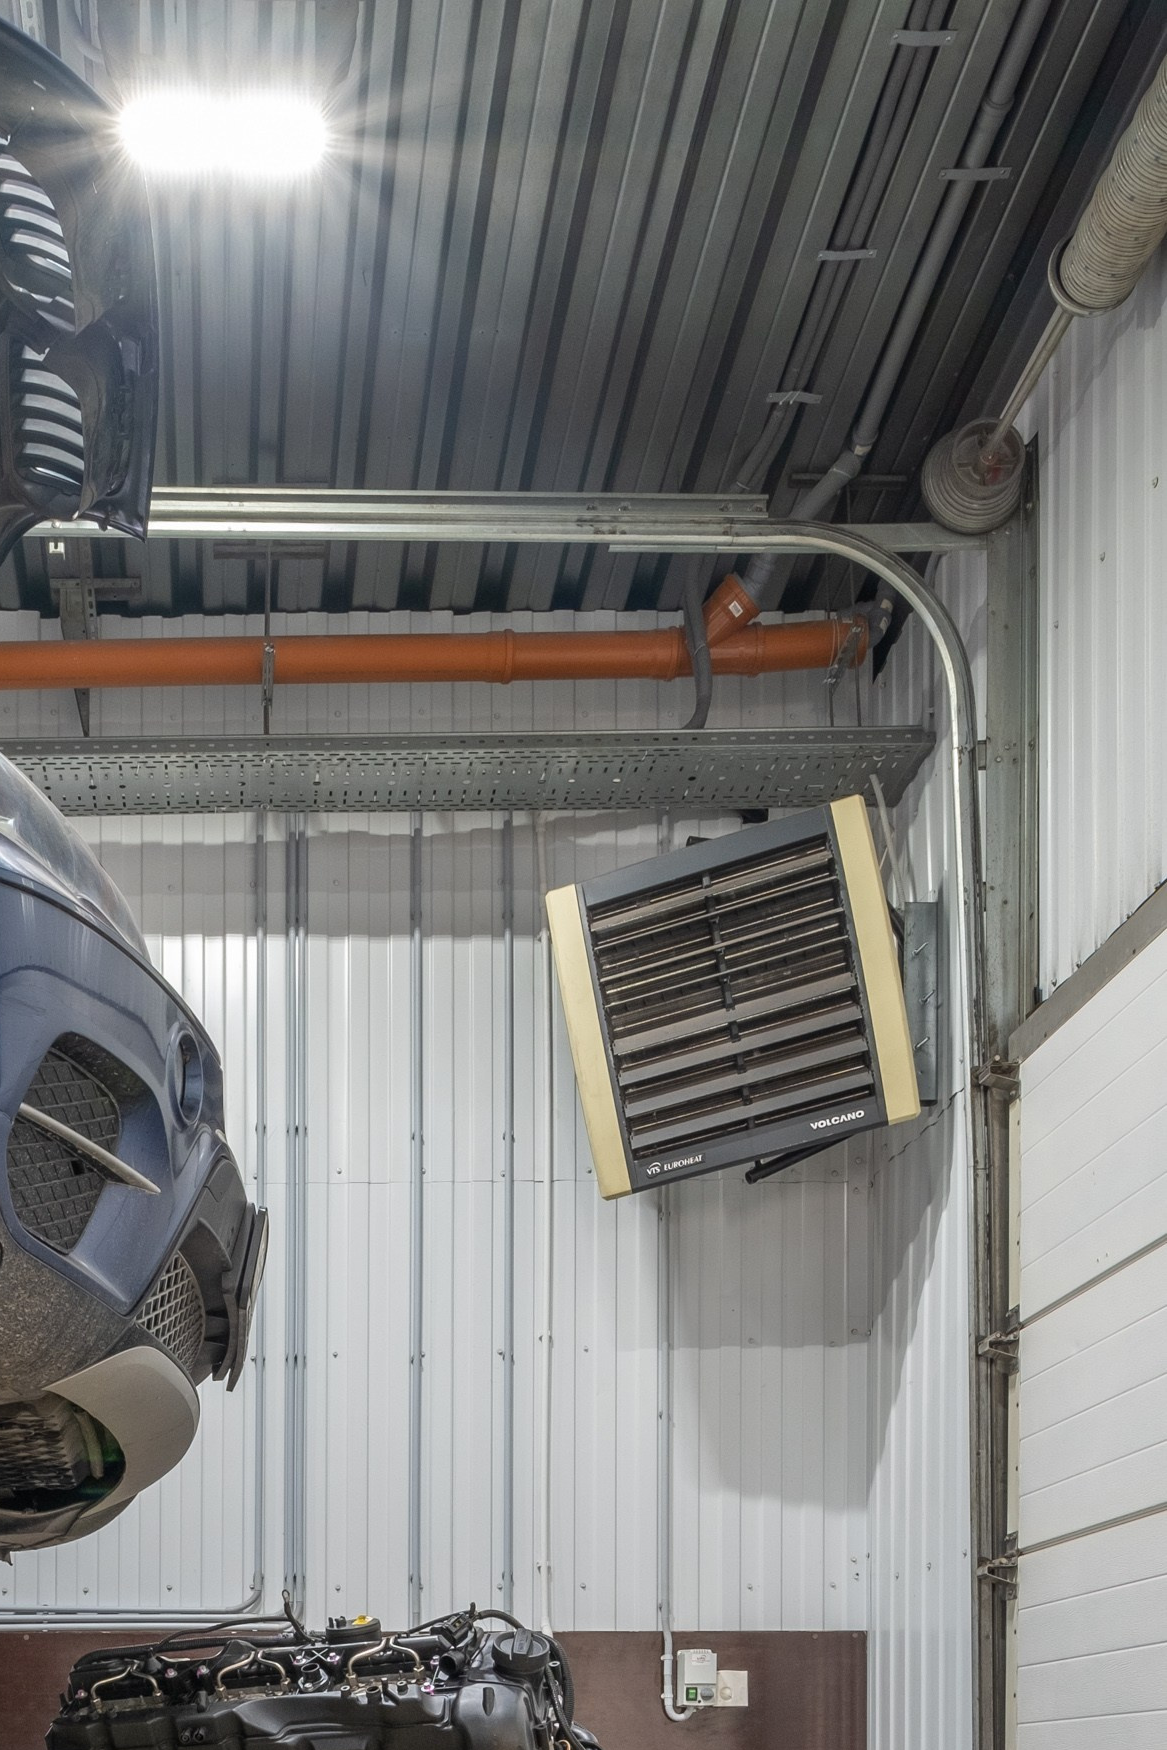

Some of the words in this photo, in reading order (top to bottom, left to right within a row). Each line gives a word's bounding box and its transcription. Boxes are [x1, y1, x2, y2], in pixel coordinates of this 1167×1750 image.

[810, 1110, 865, 1130] VOLCANO
[646, 1166, 661, 1175] VTS
[663, 1154, 703, 1171] EUROHEAT
